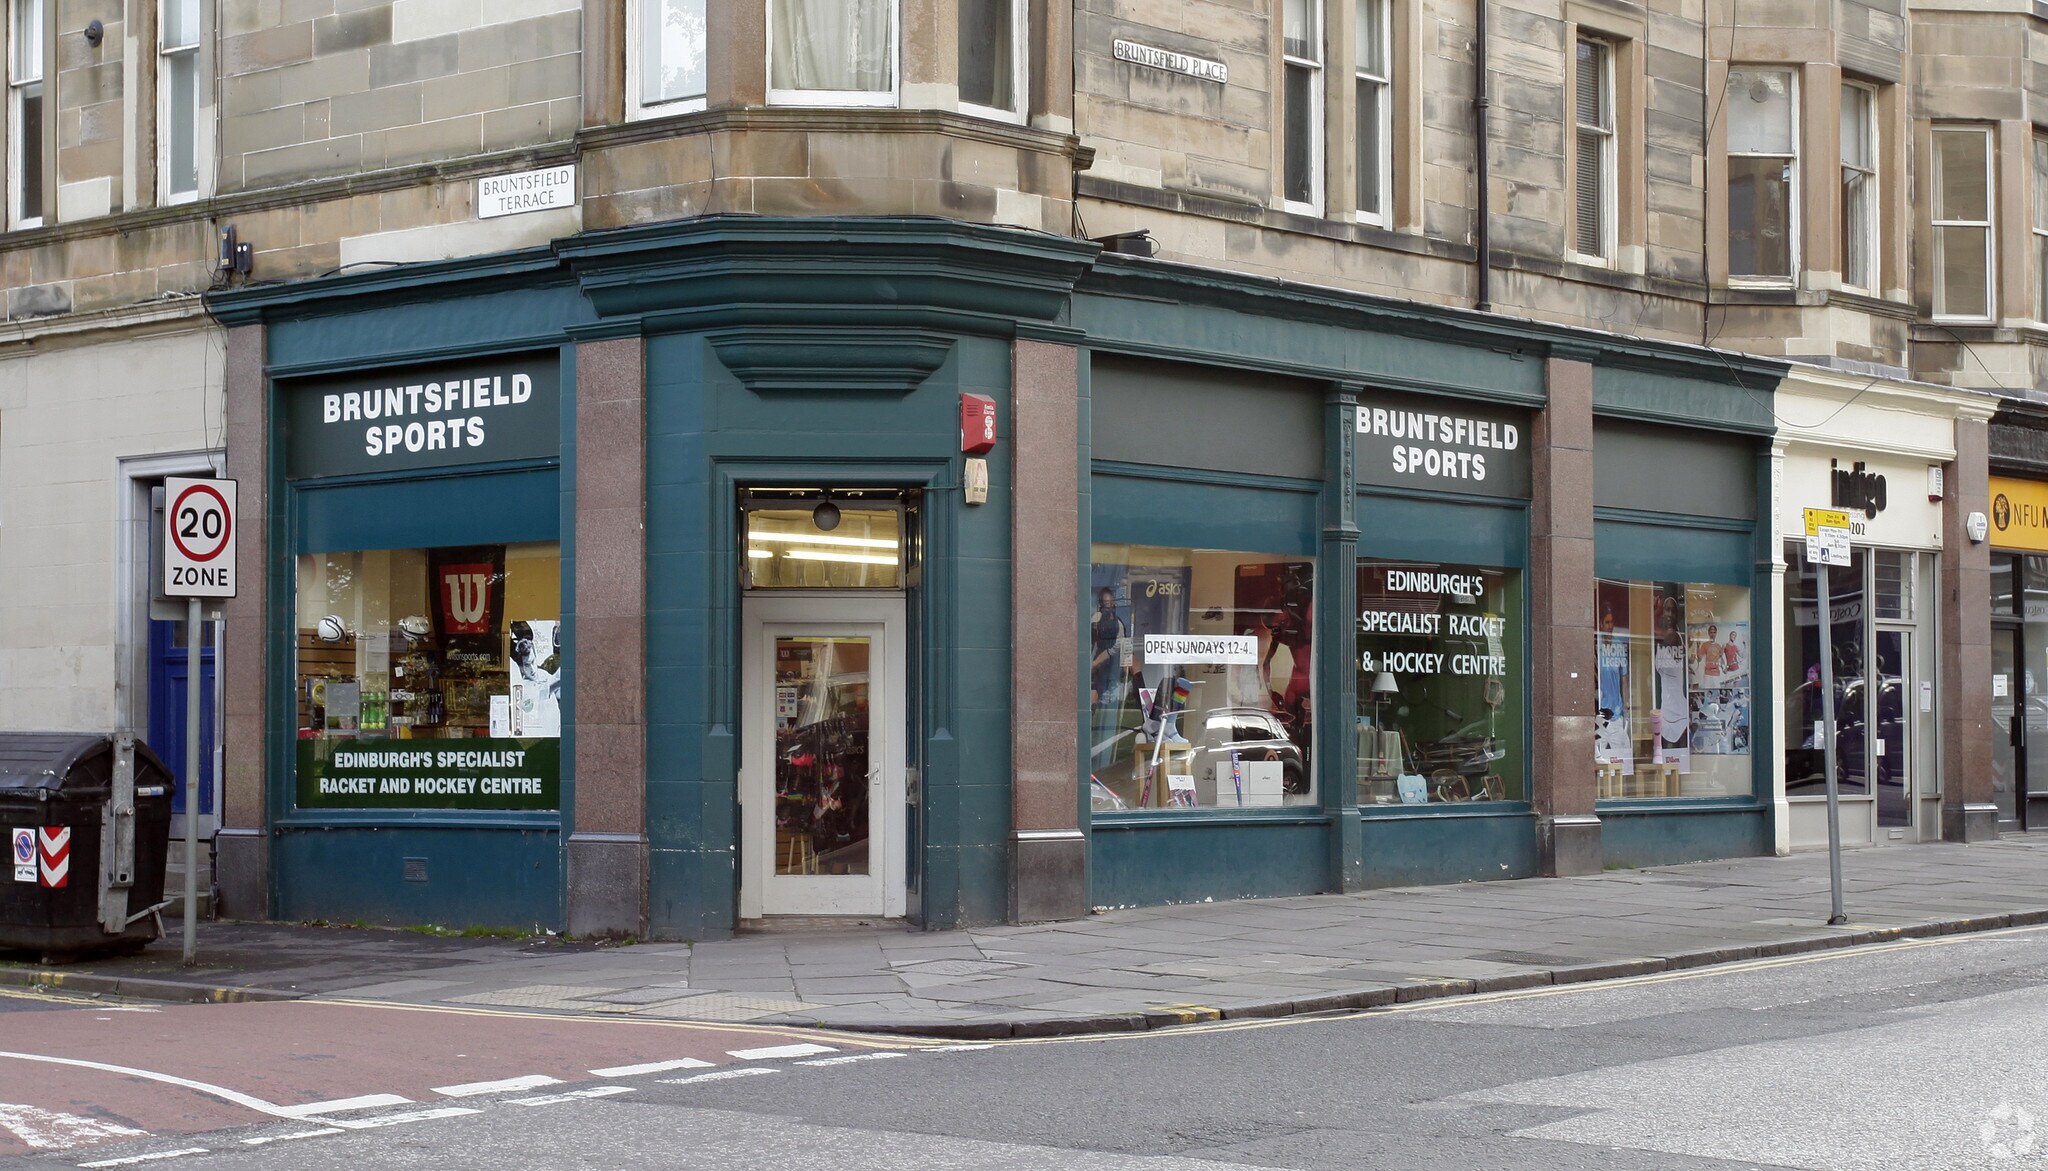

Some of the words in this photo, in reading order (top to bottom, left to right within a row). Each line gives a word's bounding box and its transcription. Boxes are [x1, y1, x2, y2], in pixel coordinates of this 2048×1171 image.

[1116, 42, 1189, 71] BRUNTSFIELD
[1193, 60, 1225, 80] PLACE
[483, 170, 569, 196] BRUNTSFIELD
[499, 190, 554, 211] TERRACE
[323, 373, 532, 424] BRUNTSFIELD
[365, 416, 485, 456] SPORTS
[1356, 406, 1519, 450] BRUNTSFIELD
[1392, 445, 1486, 481] SPORTS
[1831, 458, 1887, 520] indigo
[180, 507, 222, 539] 20
[2013, 503, 2039, 528] NFU
[1851, 522, 1866, 536] 202
[172, 567, 228, 586] ZONE
[1387, 570, 1484, 597] EDINBURGH'S
[445, 573, 487, 624] W
[1158, 583, 1182, 596] asics
[1362, 610, 1441, 634] SPECIALIST
[1449, 617, 1506, 637] RACKET
[1145, 640, 1174, 654] OPEN
[1176, 641, 1225, 654] SUNDAYS
[1601, 643, 1628, 657] MORE
[1657, 644, 1684, 658] MORE
[1362, 651, 1374, 672] &
[1383, 652, 1444, 674] HOCKEY
[1452, 654, 1506, 676] CENTRE
[1601, 657, 1628, 667] LEGEND
[334, 751, 433, 768] EDINBURGH'S
[437, 751, 526, 768] SPECIALIST
[319, 778, 377, 794] RACKET
[379, 778, 411, 794] AND
[414, 778, 477, 794] HOCKEY
[480, 778, 542, 794] CENTRE
